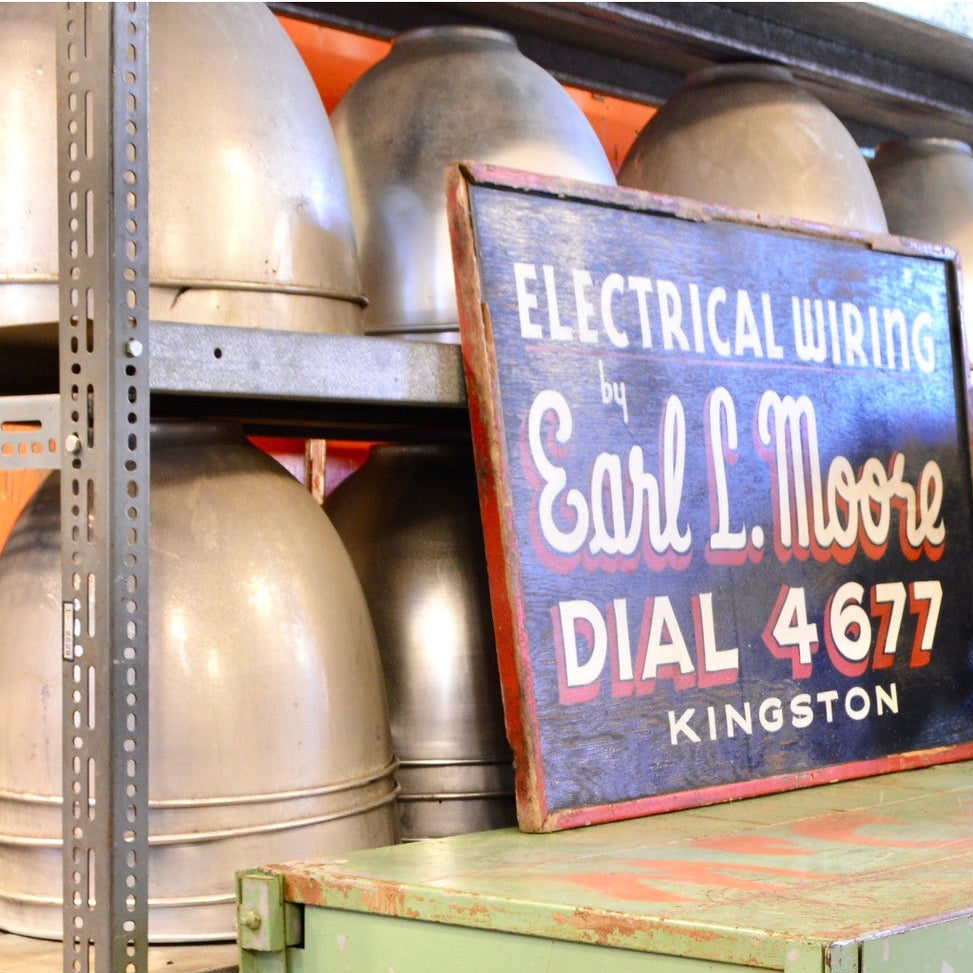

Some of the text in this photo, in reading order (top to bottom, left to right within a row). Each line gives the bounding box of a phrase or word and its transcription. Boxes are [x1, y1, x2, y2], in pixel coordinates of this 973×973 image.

[513, 262, 937, 374] ELECTRICAL WIRING
[597, 358, 629, 424] by
[525, 386, 947, 557] Earl L. Moore
[556, 579, 944, 690] DIAL 4677
[667, 683, 900, 746] KINGSTON
